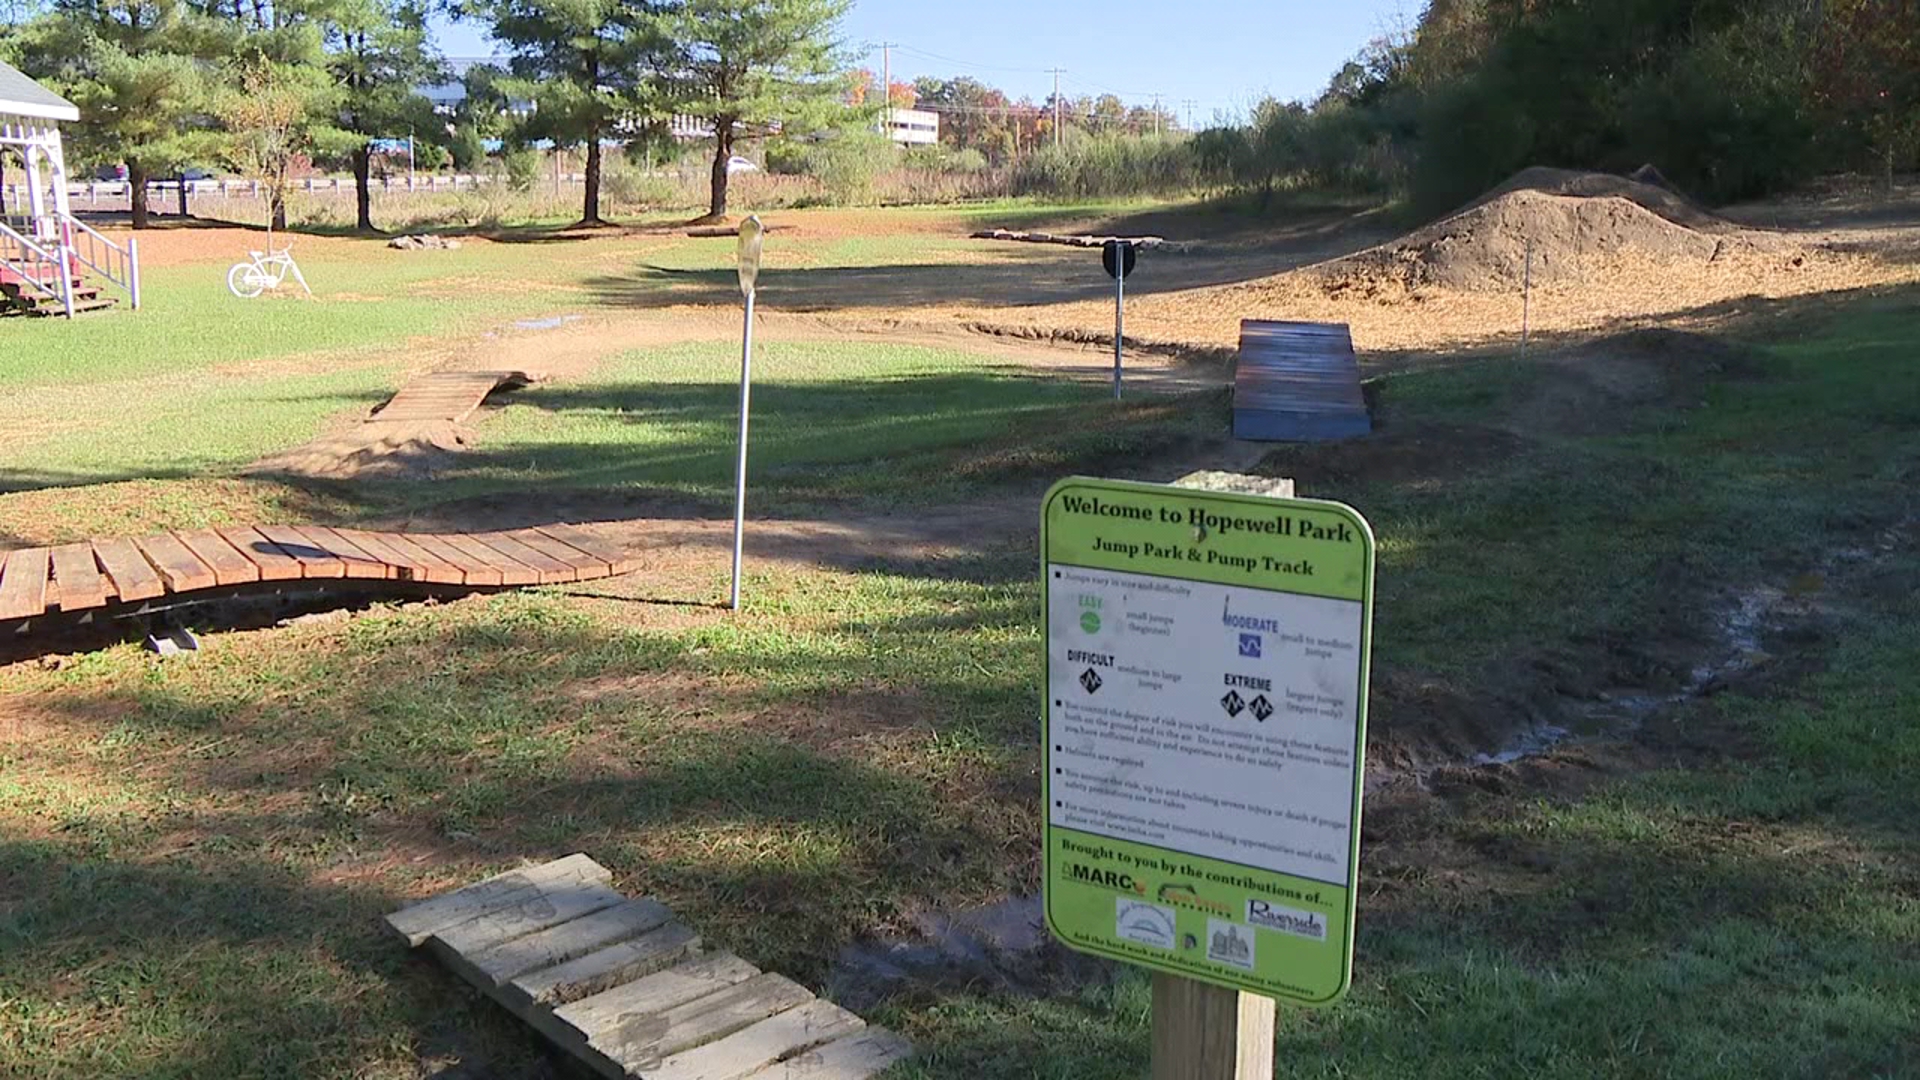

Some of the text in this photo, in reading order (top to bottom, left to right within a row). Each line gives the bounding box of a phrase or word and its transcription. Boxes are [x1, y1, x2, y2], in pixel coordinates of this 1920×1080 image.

[1063, 495, 1351, 543] Welcome to Hopewell Park
[1092, 537, 1313, 576] Jump Park & Pump Track
[1065, 572, 1090, 583] Jumps
[1092, 578, 1109, 586] vary
[1121, 580, 1136, 589] size
[1138, 582, 1153, 590] and
[1155, 583, 1191, 596] difficulty
[1079, 594, 1103, 609] EASY
[1126, 612, 1174, 624] small jumps
[1223, 615, 1278, 633] MODERATE
[1280, 634, 1303, 643] small
[1306, 636, 1314, 645] to
[1067, 649, 1115, 667] DIFFICULT
[1117, 665, 1150, 676] medium
[1162, 670, 1181, 682] large
[1224, 673, 1271, 692] EXTREME
[1061, 839, 1114, 860] Brought
[1117, 852, 1131, 863] to
[1134, 856, 1158, 869] you
[1161, 859, 1177, 875] by
[1180, 865, 1202, 879] the
[1206, 871, 1301, 899] contributions
